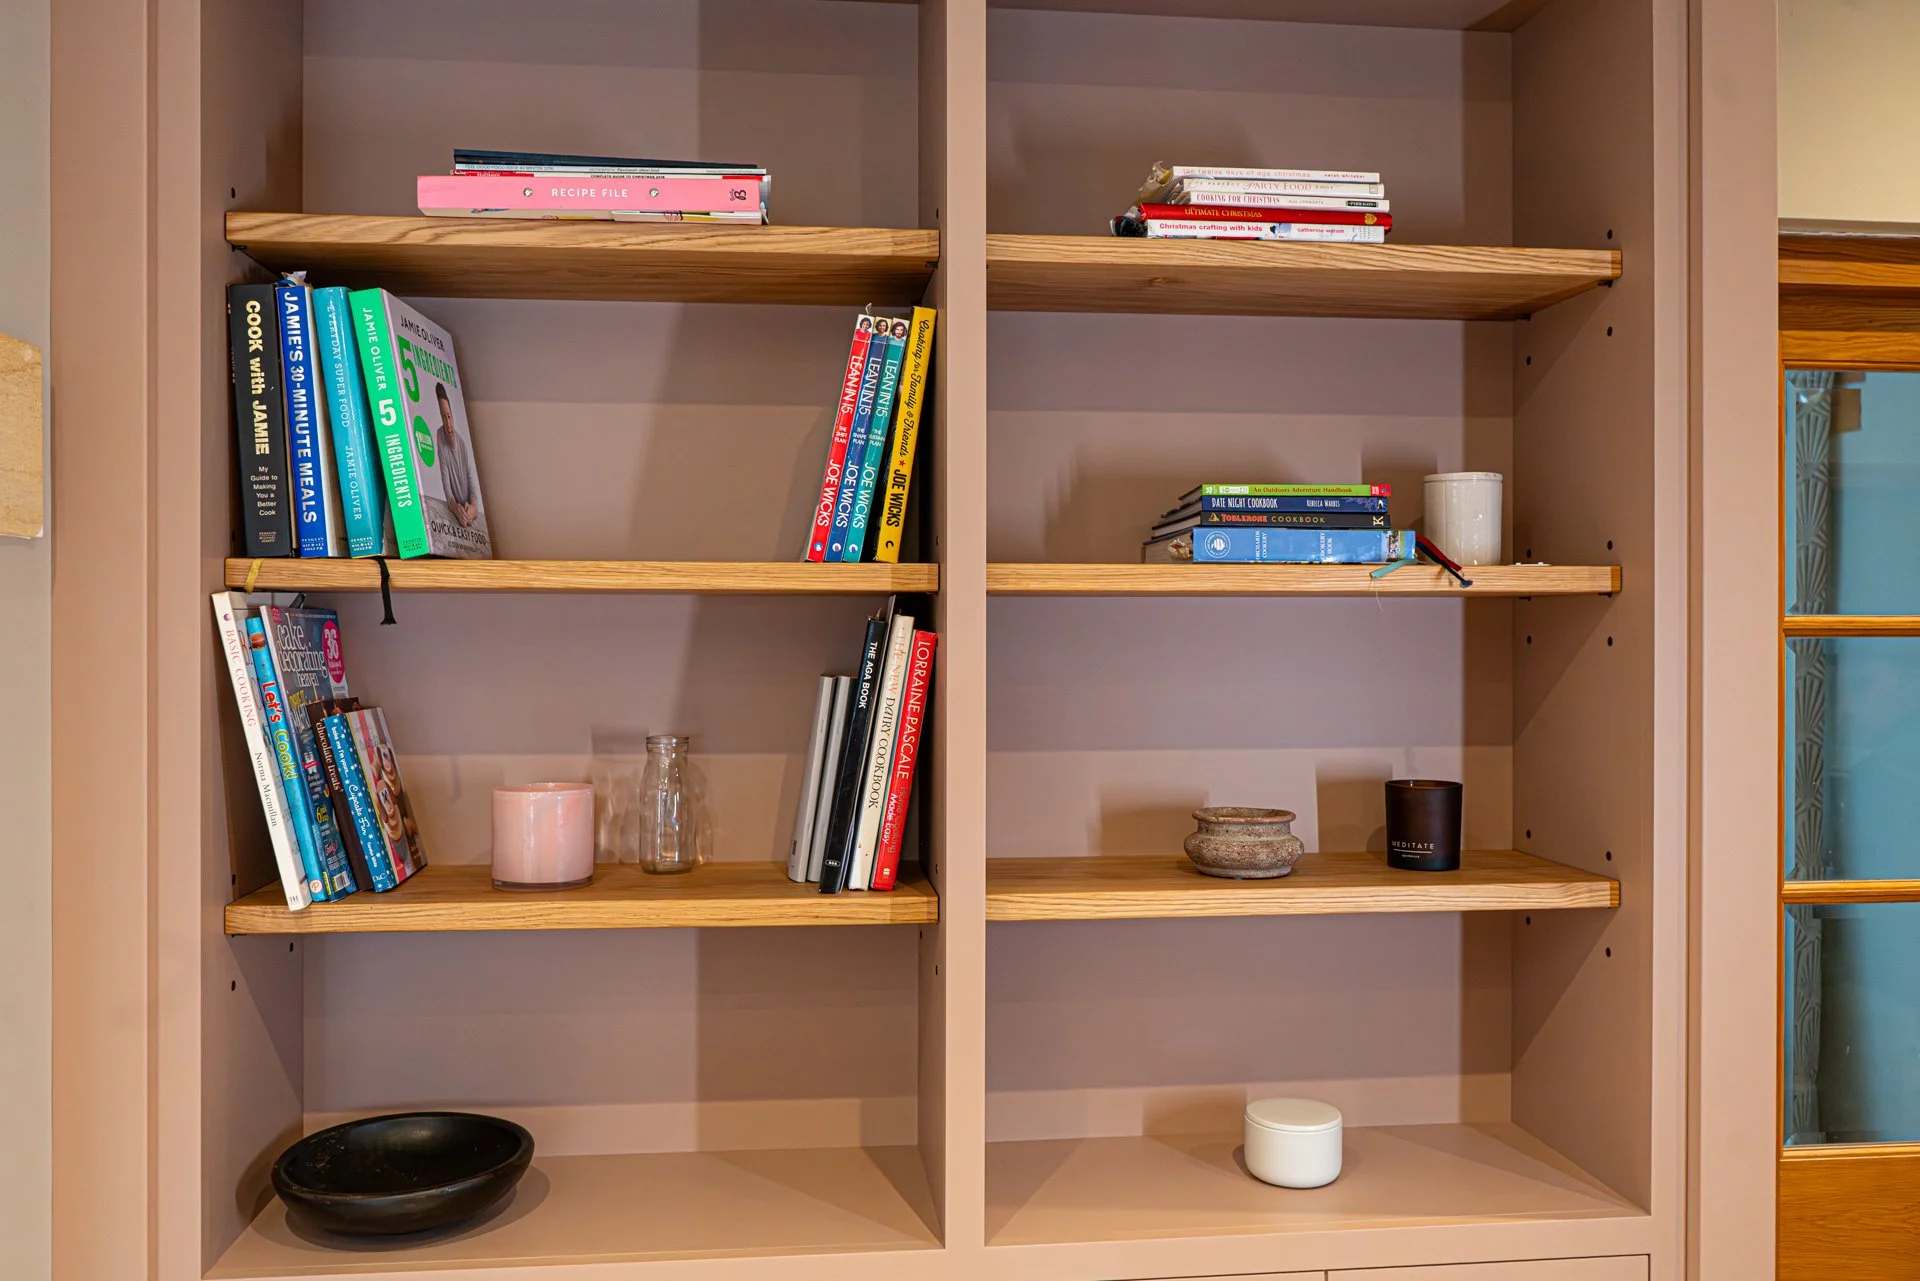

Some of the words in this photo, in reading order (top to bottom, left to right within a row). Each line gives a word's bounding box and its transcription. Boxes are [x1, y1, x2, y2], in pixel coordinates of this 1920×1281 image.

[551, 188, 596, 197] RECIPE
[602, 188, 628, 198] FILE
[1228, 194, 1240, 202] FOR
[1243, 195, 1280, 203] CHRISTMAS
[1244, 182, 1280, 190] PARTY
[1184, 207, 1220, 216] ULTIMATE
[1222, 209, 1262, 218] CHRISTMAS
[1199, 224, 1227, 232] crafting
[246, 300, 263, 353] COOK
[284, 292, 303, 362] JAMIE'S
[327, 306, 342, 360] EVERYDAY
[363, 308, 378, 343] JAMIE
[401, 316, 421, 337] JAMIE
[421, 328, 445, 352] OLIVER
[912, 320, 930, 360] Cooking
[250, 357, 265, 394] with
[335, 363, 346, 396] SUPER
[371, 347, 386, 390] OLIVER
[397, 334, 420, 403] 5
[411, 342, 458, 389] INGREDIENTS
[845, 355, 863, 387] LEAN
[864, 357, 882, 390] LEAN
[882, 359, 898, 391] LEAN
[914, 361, 922, 373] for
[842, 388, 856, 402] IN
[861, 390, 874, 403] IN
[878, 392, 891, 405] IN
[904, 373, 922, 410] Family
[290, 366, 312, 458] 30-MINUTE
[339, 398, 350, 428] FOOD
[379, 398, 397, 426] 5
[841, 402, 854, 414] 15
[860, 403, 872, 415] 15
[876, 405, 888, 417] 15
[252, 400, 270, 455] JAMIE
[900, 418, 915, 457] Friends
[345, 446, 356, 478] JAMIE
[385, 434, 412, 508] INGREDIENTS
[826, 459, 841, 485] JOE
[844, 461, 859, 486] JOE
[861, 462, 876, 487] JOE
[298, 462, 317, 524] MEALS
[892, 469, 907, 491] JOE
[350, 481, 362, 520] OLIVER
[817, 487, 836, 527] WICKS
[836, 488, 855, 528] WICKS
[852, 490, 871, 529] WICKS
[886, 493, 904, 528] WICKS
[1212, 498, 1226, 508] DATE
[1228, 498, 1245, 508] NIGHT
[1248, 498, 1278, 508] COOKBOOK
[431, 520, 452, 536] QUICK
[457, 527, 470, 541] EASY
[471, 531, 486, 545] FOOD
[1221, 514, 1267, 522] TOBLERONE
[1373, 516, 1384, 526] K
[277, 612, 304, 650] cake
[324, 628, 339, 659] 36
[278, 642, 328, 678] decorating
[868, 642, 878, 660] THE
[226, 629, 240, 664] BASIC
[235, 668, 256, 727] COOKING
[864, 660, 874, 680] AGA
[908, 641, 931, 713] LORRAINE
[858, 682, 870, 709] BOOK
[262, 681, 282, 723] Let's
[274, 729, 298, 780] Cook!
[896, 716, 918, 779] PASCALE
[255, 752, 266, 782] Norma
[263, 784, 278, 827] Macmillan
[869, 738, 888, 809] COOKBOOK
[348, 784, 362, 816] Cupcake
[358, 817, 370, 836] Fun
[887, 793, 900, 820] Made
[882, 823, 892, 844] Easy
[1392, 841, 1435, 849] MEDITATE
